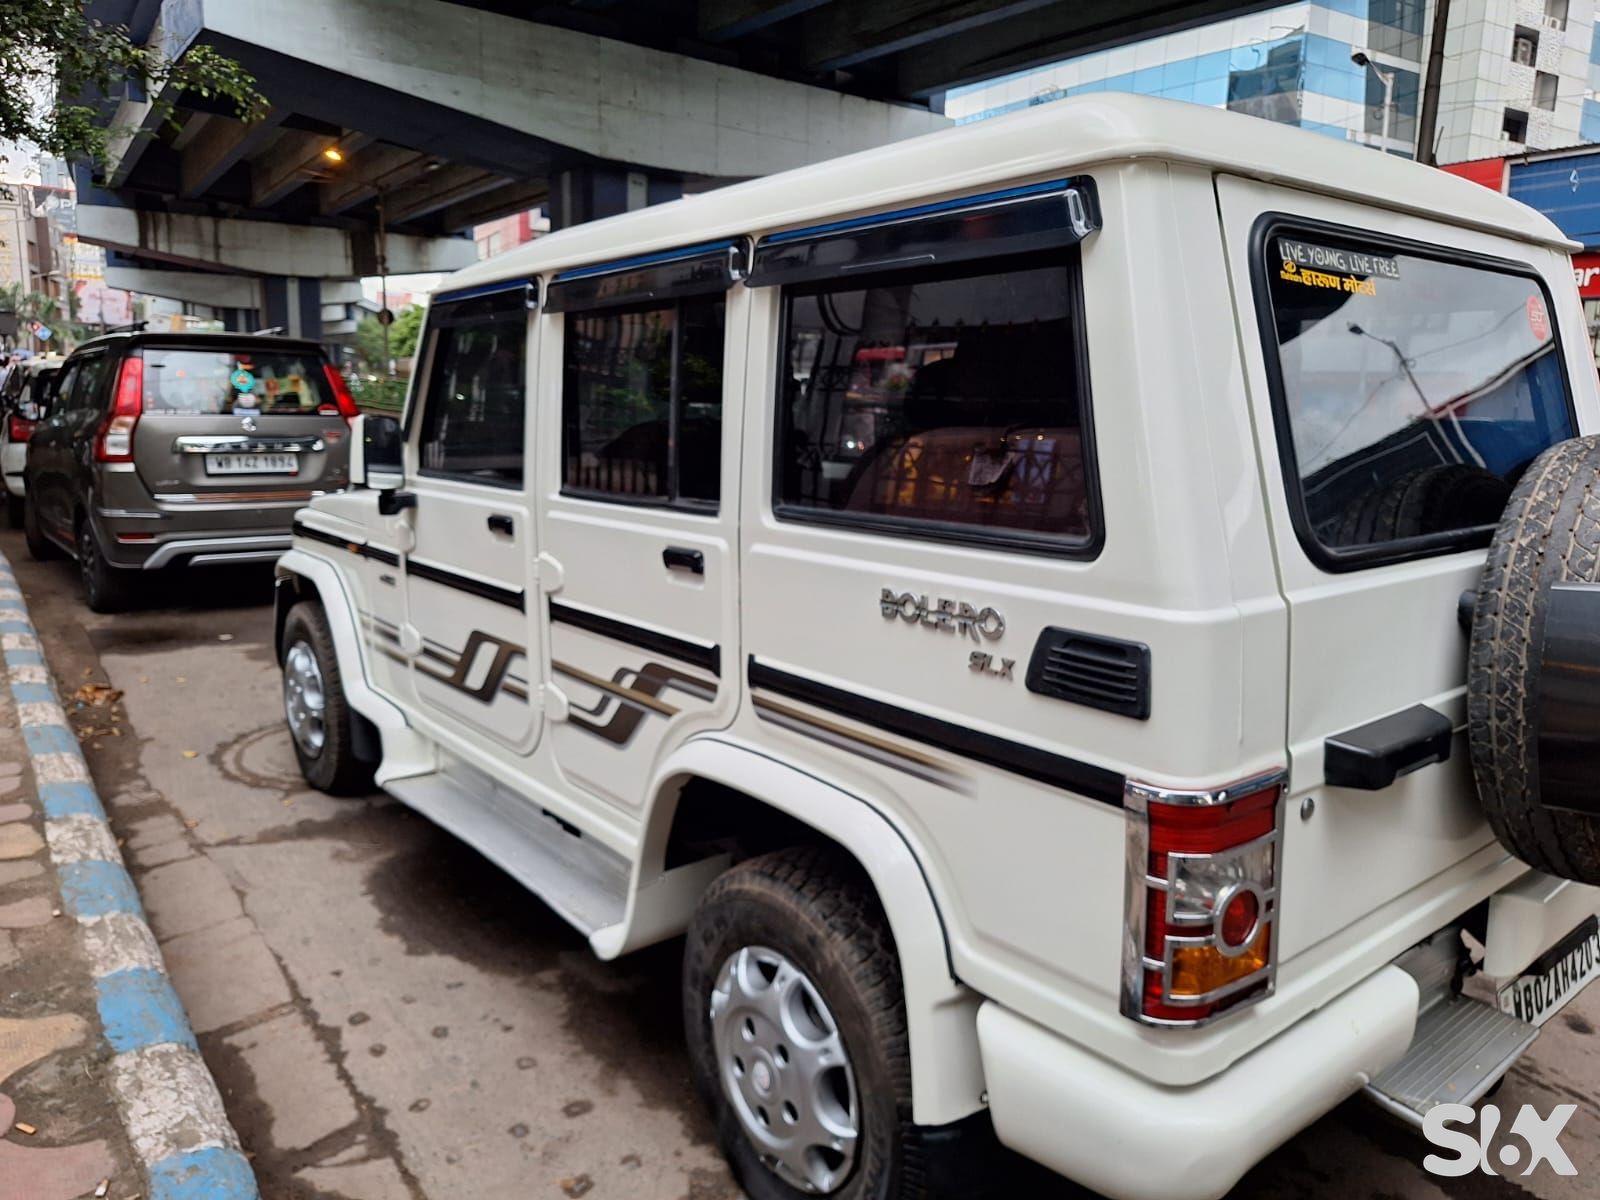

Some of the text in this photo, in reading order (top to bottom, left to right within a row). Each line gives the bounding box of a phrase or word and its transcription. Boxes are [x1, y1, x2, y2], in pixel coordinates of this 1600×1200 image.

[1279, 242, 1306, 263] LIVE
[1349, 254, 1373, 274] LIVE
[1373, 258, 1399, 278] FREE
[880, 587, 1007, 644] BOLERO
[967, 650, 1016, 681] SLX
